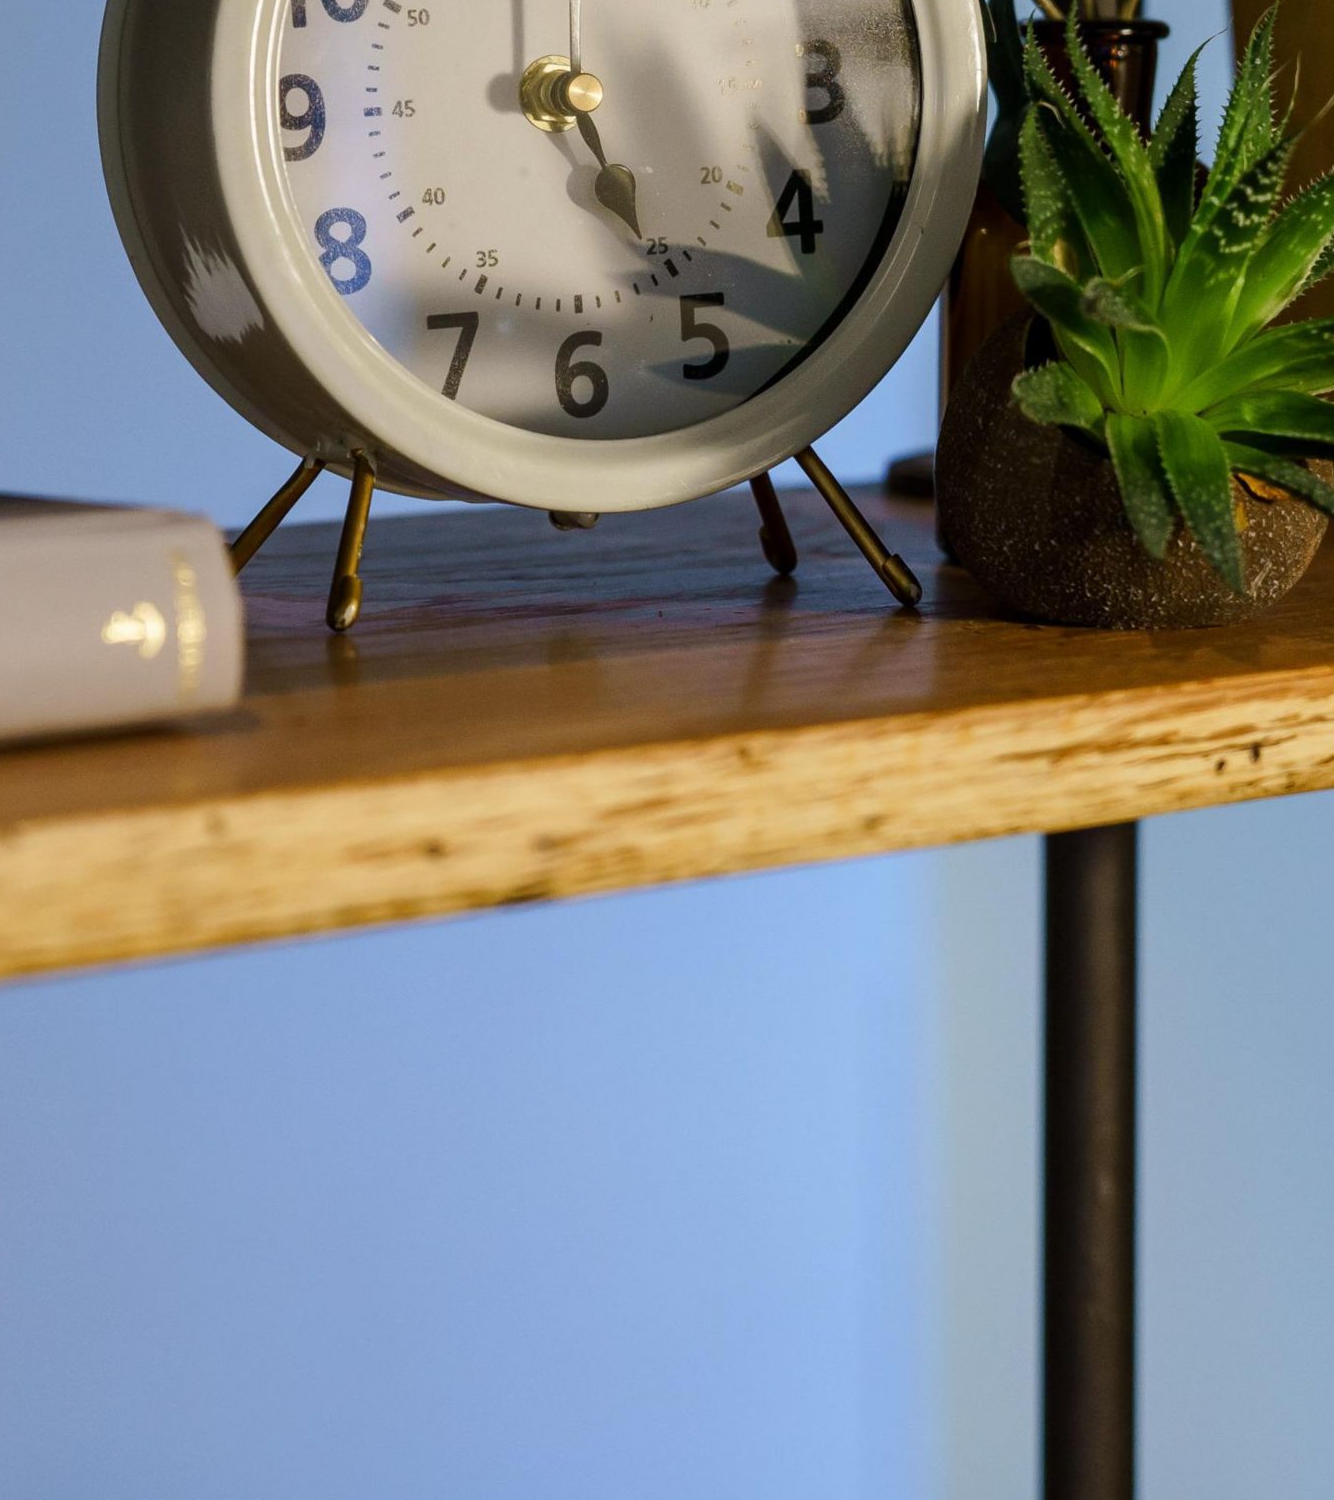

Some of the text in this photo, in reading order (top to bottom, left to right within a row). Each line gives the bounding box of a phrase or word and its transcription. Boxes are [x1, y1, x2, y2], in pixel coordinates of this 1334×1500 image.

[407, 8, 430, 27] 50
[279, 73, 326, 162] 9
[391, 100, 416, 119] 45
[795, 38, 846, 125] 3
[421, 187, 446, 206] 40
[700, 165, 723, 185] 20
[766, 168, 824, 254] 4
[314, 207, 372, 296] 8
[475, 249, 499, 268] 35
[646, 236, 669, 255] 25
[426, 311, 479, 400] 7
[555, 330, 609, 418] 6
[680, 292, 730, 380] 5
